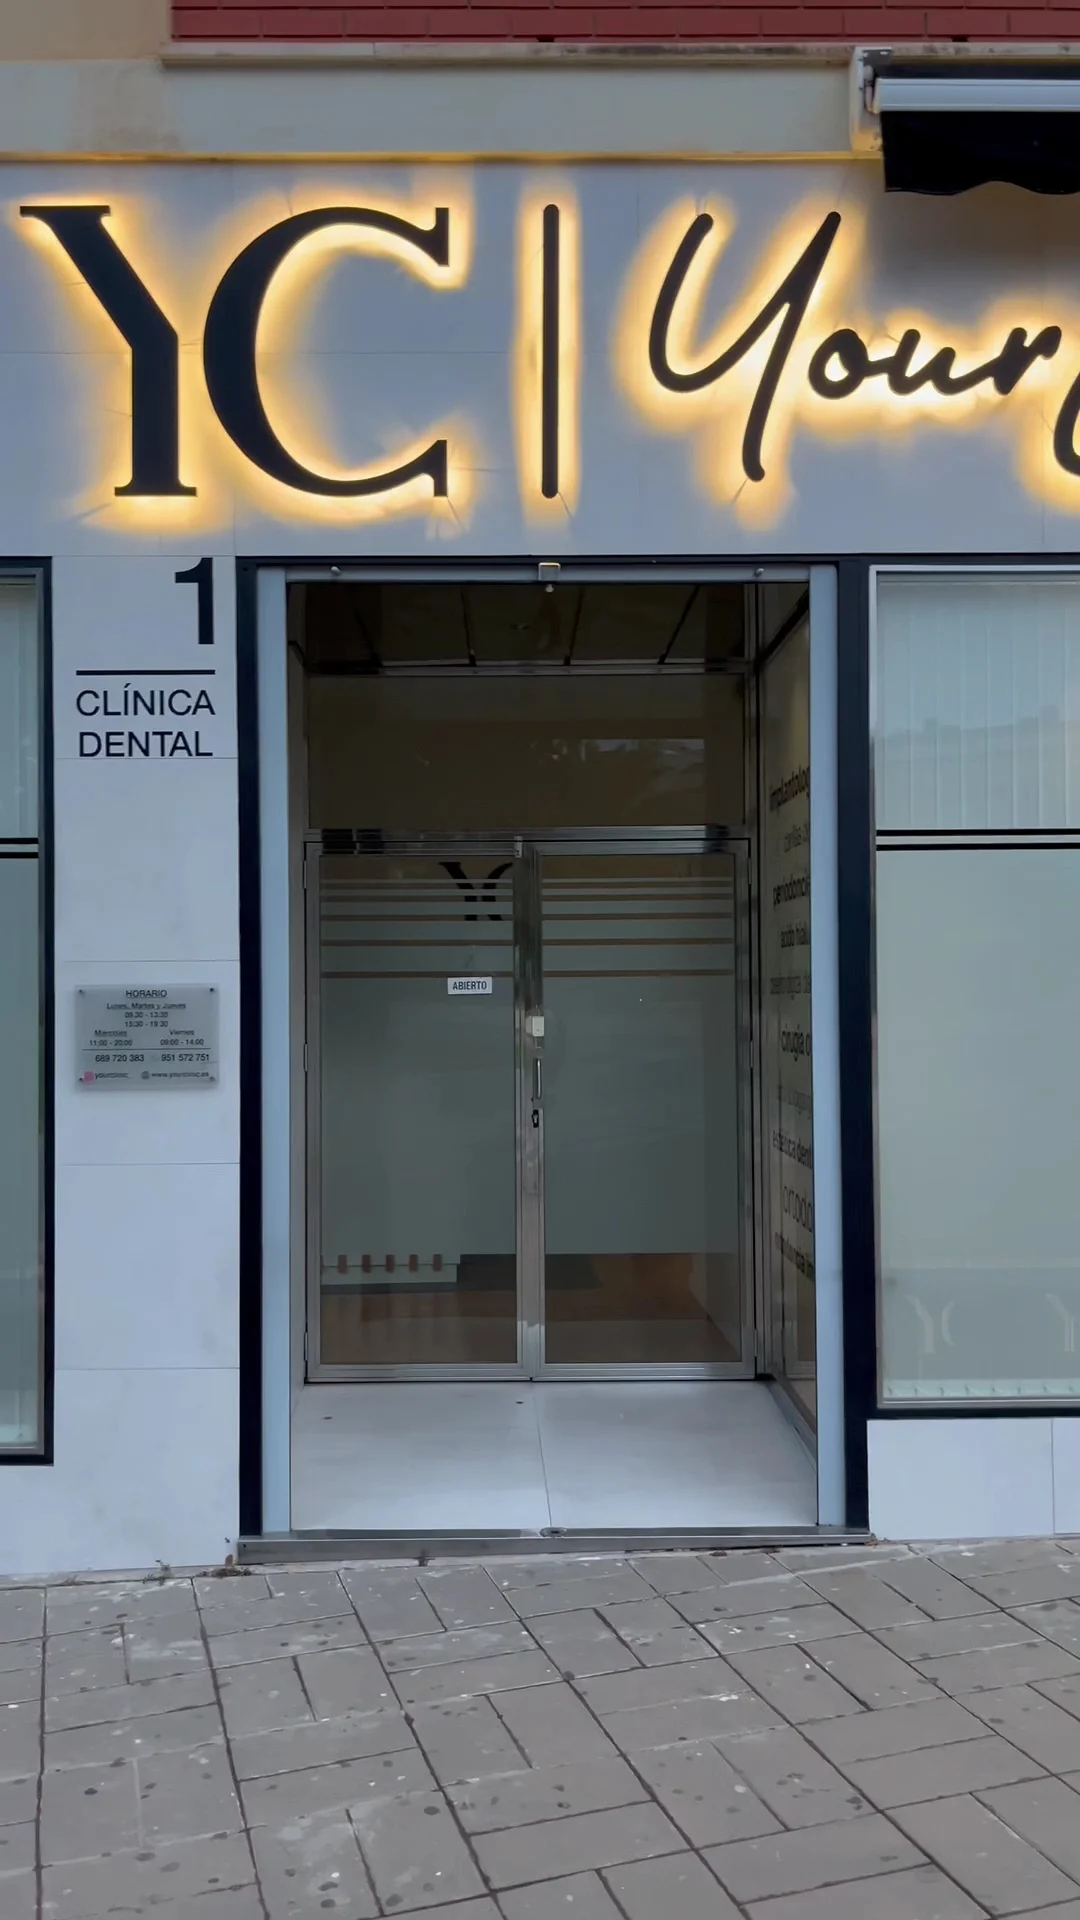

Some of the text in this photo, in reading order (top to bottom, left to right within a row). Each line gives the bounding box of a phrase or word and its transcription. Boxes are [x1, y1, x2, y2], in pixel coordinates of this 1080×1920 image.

[20, 204, 1063, 497] YC Your
[175, 557, 214, 645] 1
[76, 683, 216, 716] CLÍNICA
[79, 731, 213, 757] DENTAL
[125, 989, 168, 998] HORARIO
[452, 981, 487, 990] ABIERTO
[94, 1053, 209, 1062] 689 720 383 951 572 751
